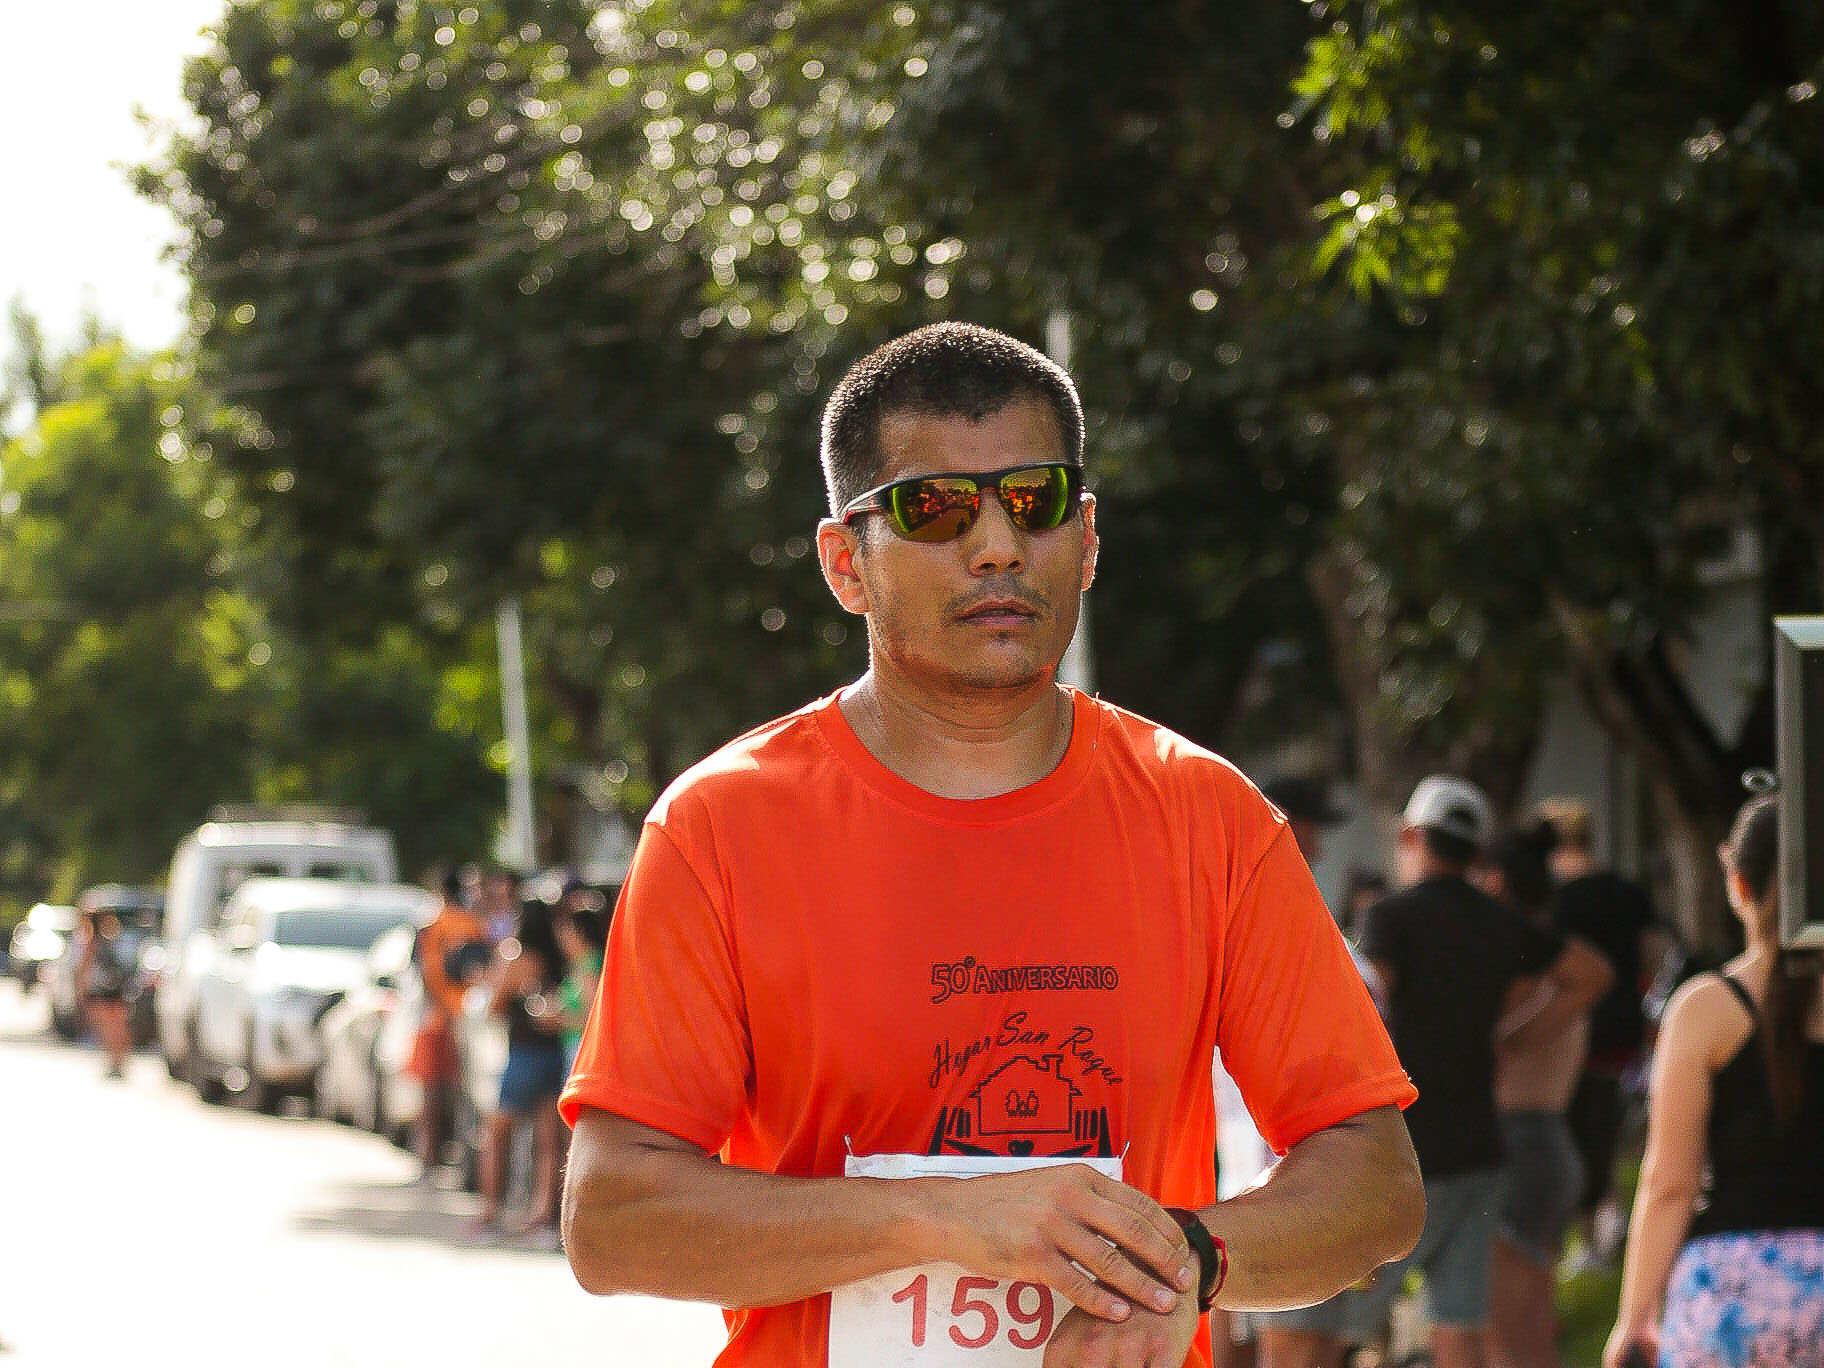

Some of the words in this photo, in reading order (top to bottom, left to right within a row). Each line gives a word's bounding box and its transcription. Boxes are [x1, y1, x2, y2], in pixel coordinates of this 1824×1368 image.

[973, 965, 1119, 994] ANIVERSARIO
[928, 1036, 991, 1089] Hogar
[996, 1010, 1050, 1046] San
[1057, 1025, 1123, 1087] Roque
[891, 1273, 1055, 1350] 159
